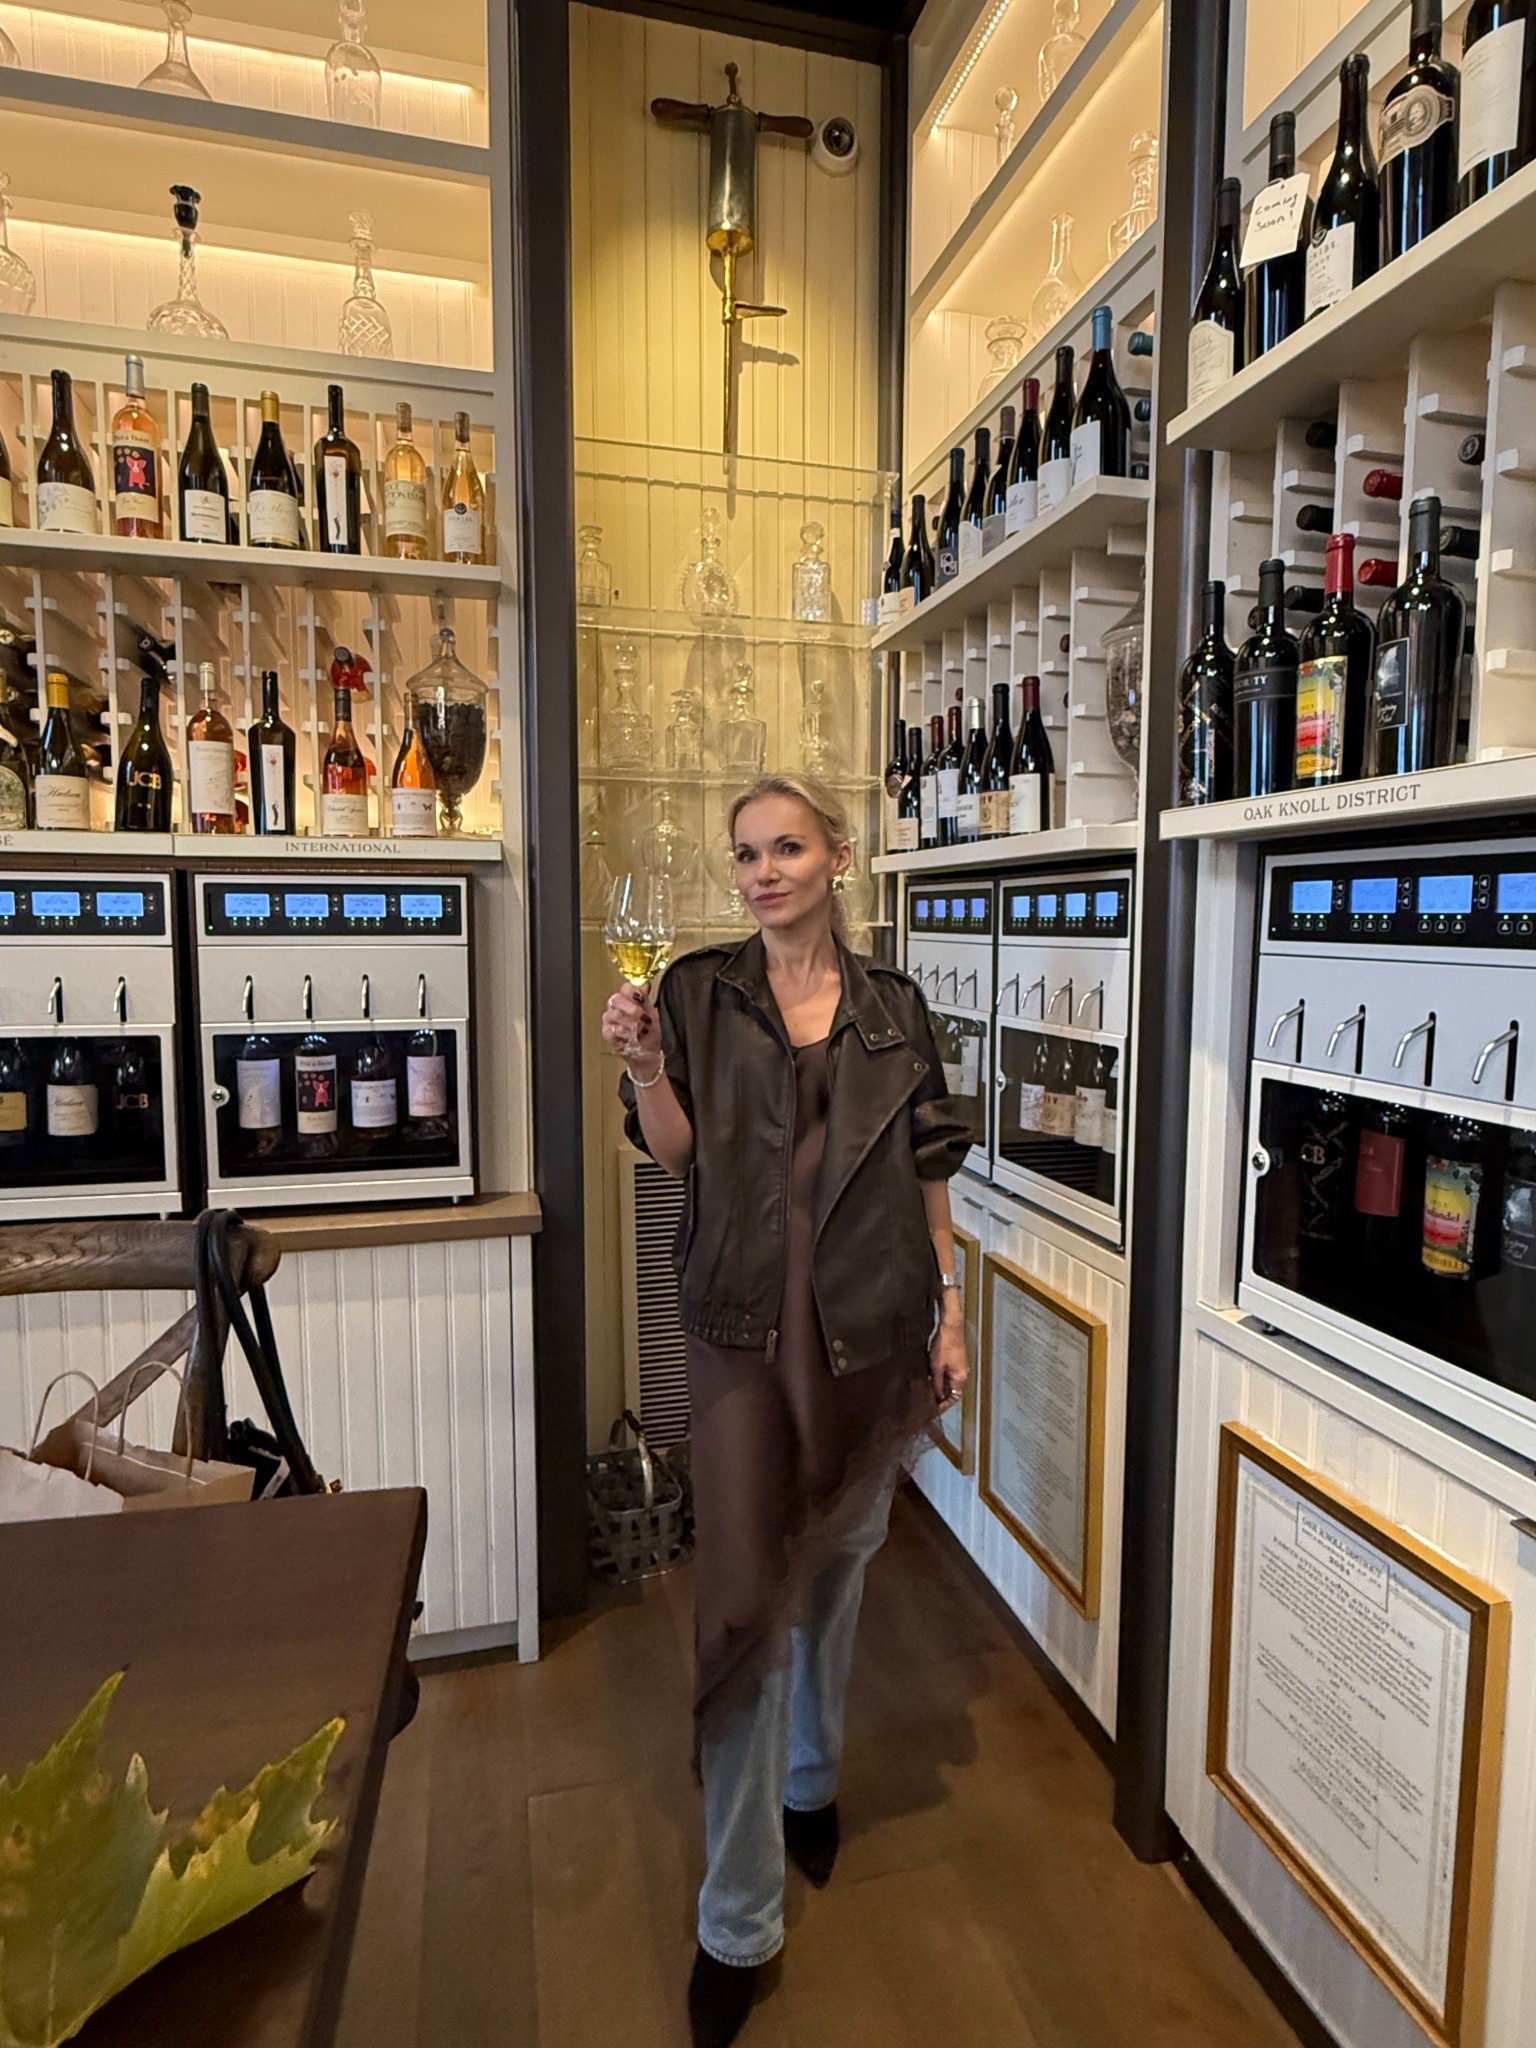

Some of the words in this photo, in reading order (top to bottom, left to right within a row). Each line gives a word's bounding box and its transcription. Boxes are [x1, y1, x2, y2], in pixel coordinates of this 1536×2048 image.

[1244, 804, 1273, 821] OAK
[1279, 796, 1330, 817] KNOLL
[1337, 784, 1421, 810] DISTRICT
[285, 842, 400, 854] INTERNATIONAL
